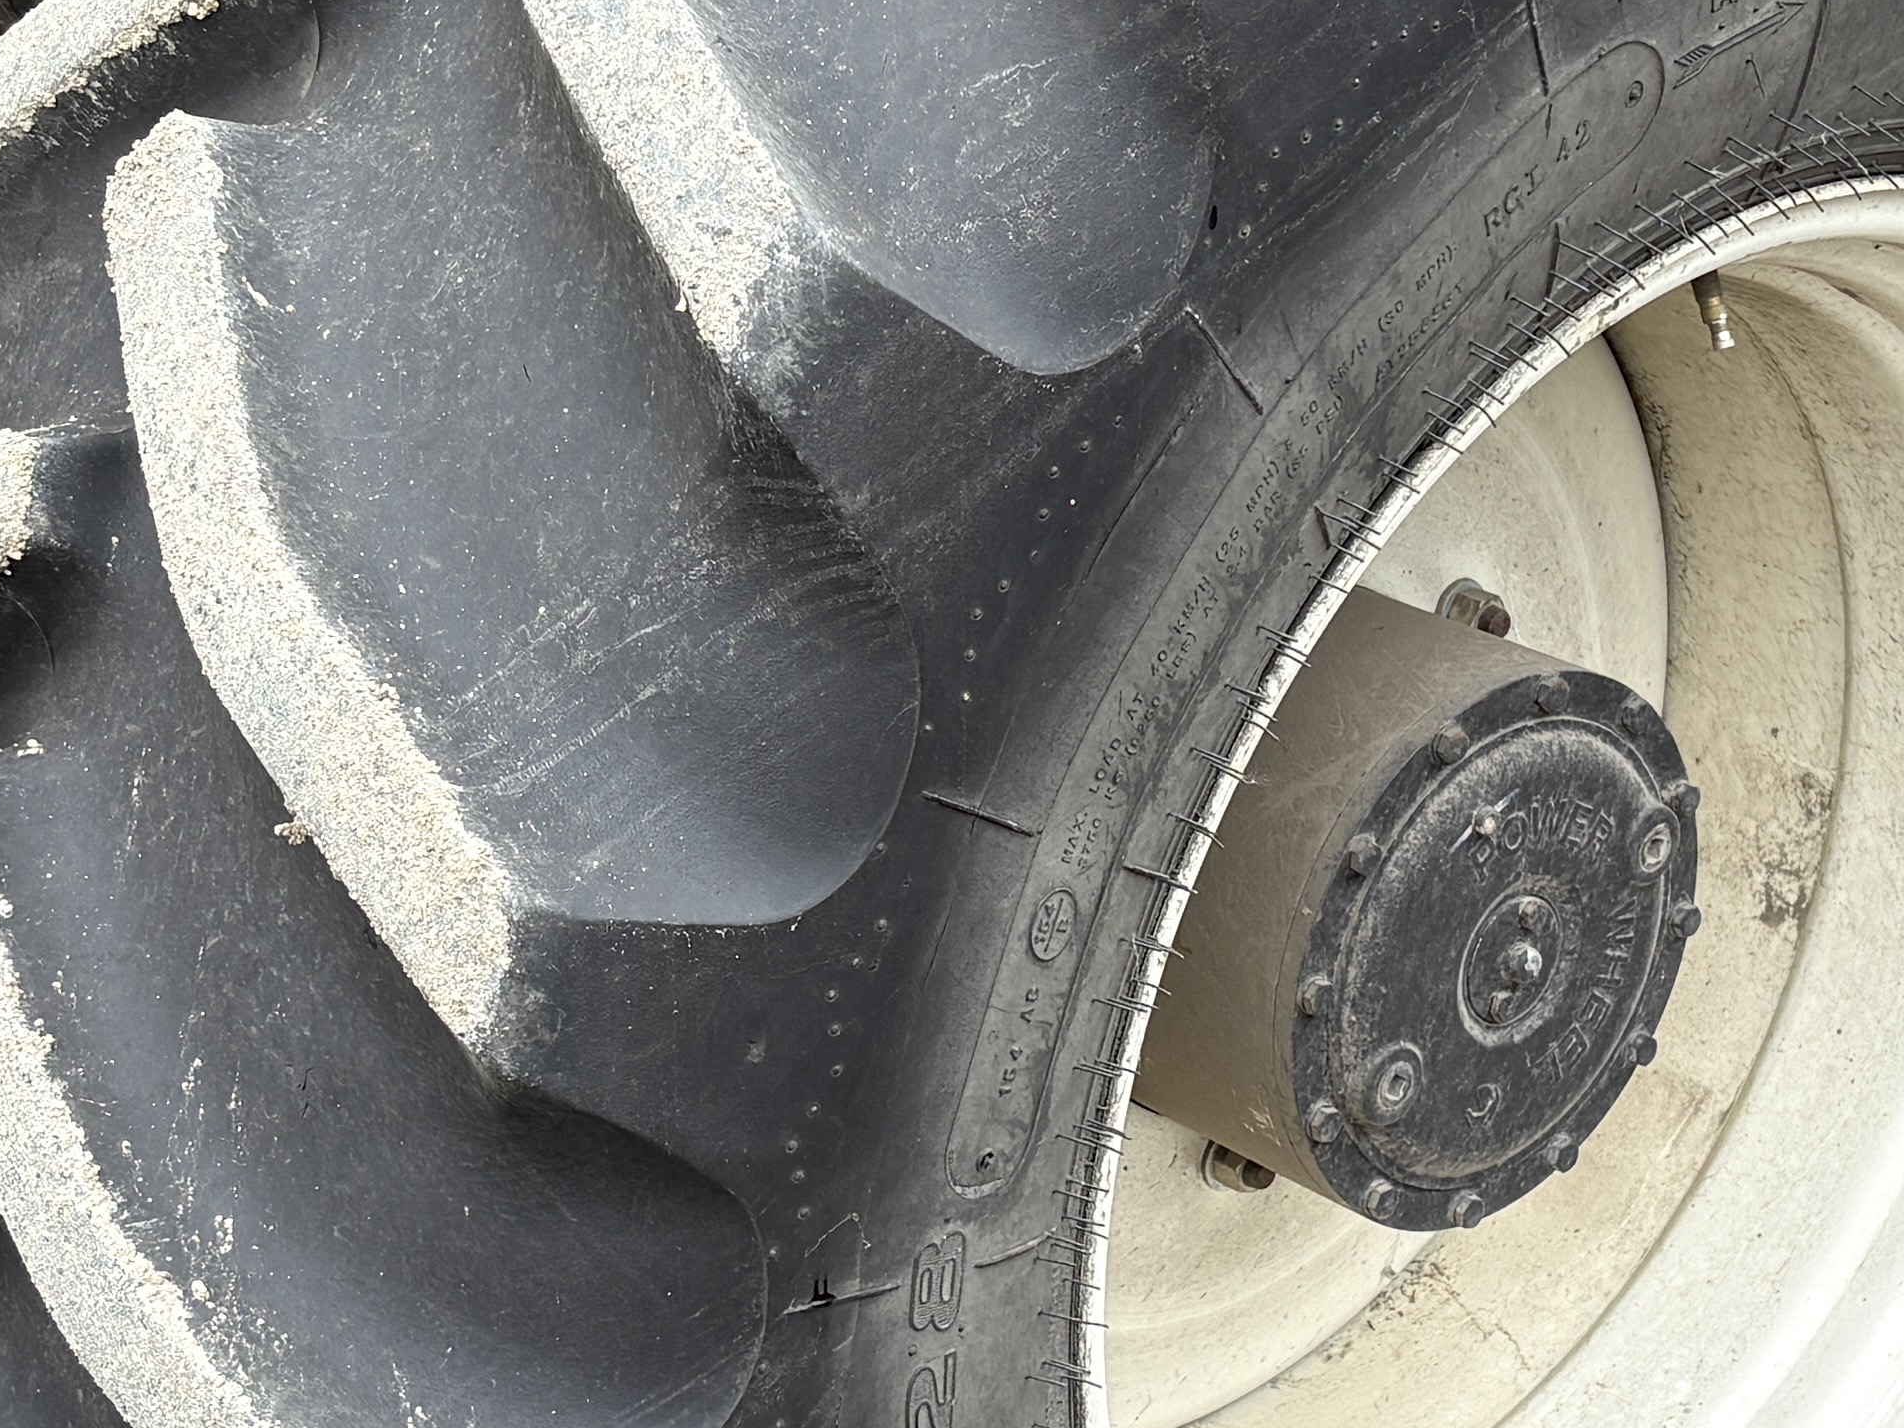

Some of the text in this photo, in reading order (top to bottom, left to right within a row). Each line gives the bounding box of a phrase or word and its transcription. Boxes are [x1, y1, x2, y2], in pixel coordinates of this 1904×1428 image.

[1087, 736, 1123, 796] LOAD
[1124, 691, 1147, 722] AT
[1149, 650, 1169, 679] 40
[1174, 575, 1212, 636] KM/H
[1215, 525, 1243, 565] (25
[1243, 461, 1282, 513] MPH)
[1469, 794, 1616, 884] POWER
[1526, 894, 1636, 1082] WHEEL
